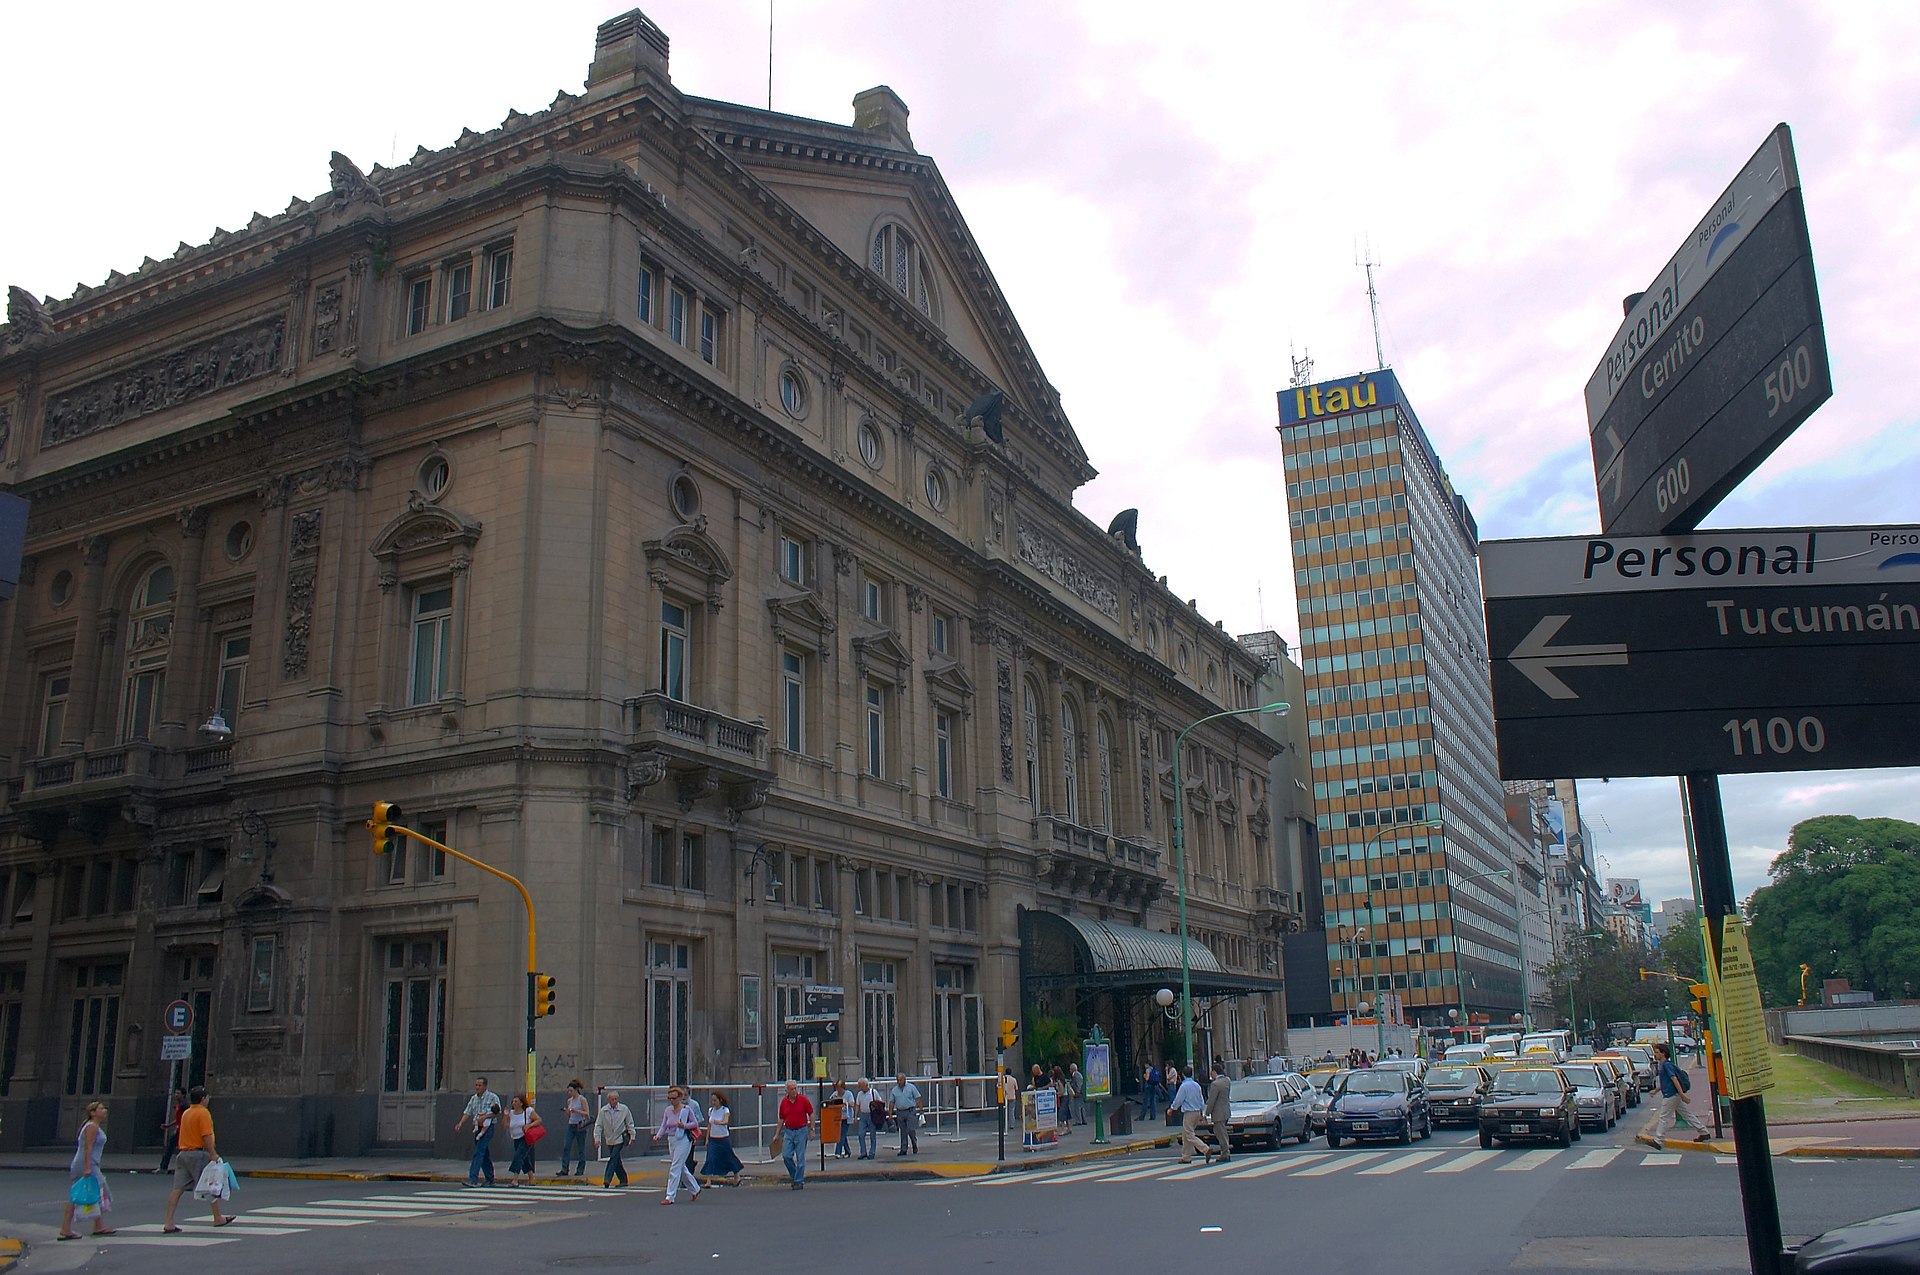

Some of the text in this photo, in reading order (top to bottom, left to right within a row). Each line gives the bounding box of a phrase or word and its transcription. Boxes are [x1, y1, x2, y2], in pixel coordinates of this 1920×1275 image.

[1699, 191, 1736, 247] Personal
[1606, 263, 1679, 396] Personal
[1641, 316, 1704, 399] Cerrito
[1764, 345, 1811, 418] 500
[1296, 376, 1377, 419] Itaú
[1656, 457, 1691, 513] 600
[1584, 533, 1816, 579] Personal
[1706, 592, 1920, 636] Tucumán
[1722, 716, 1825, 756] 1100
[173, 1007, 186, 1026] E
